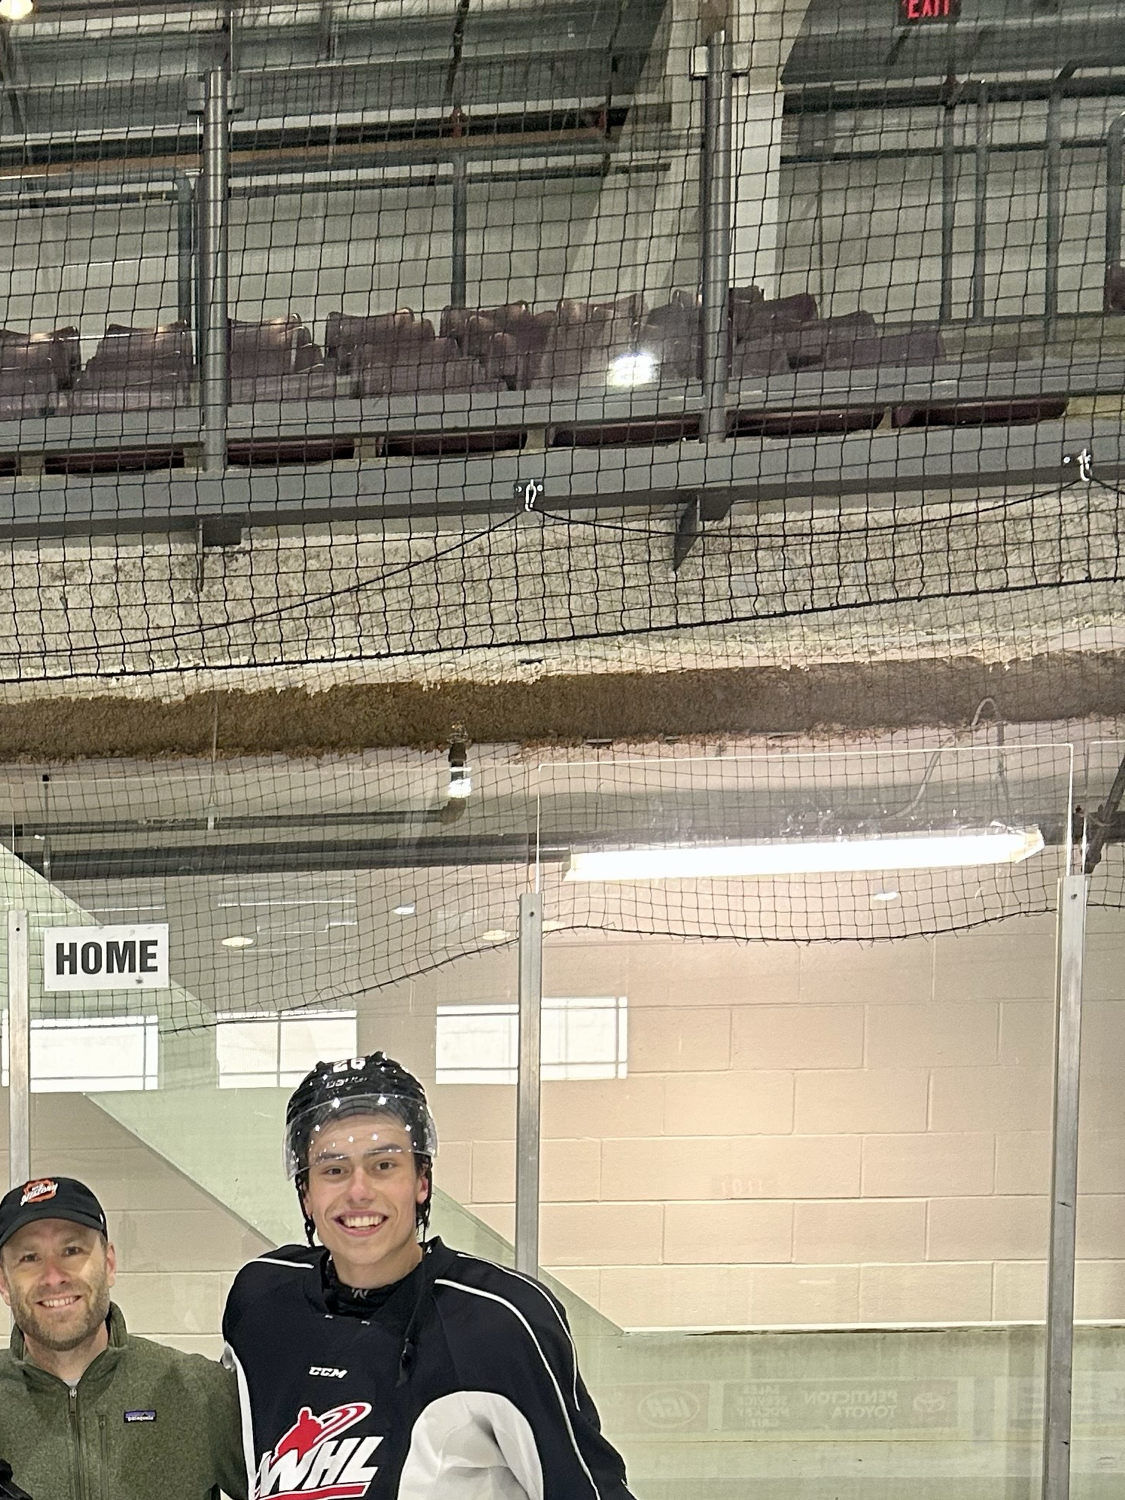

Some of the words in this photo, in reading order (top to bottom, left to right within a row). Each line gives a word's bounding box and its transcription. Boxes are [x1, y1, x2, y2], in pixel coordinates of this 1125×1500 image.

[56, 940, 158, 975] HOME
[309, 1366, 348, 1379] CCM
[259, 1436, 384, 1498] WHL
